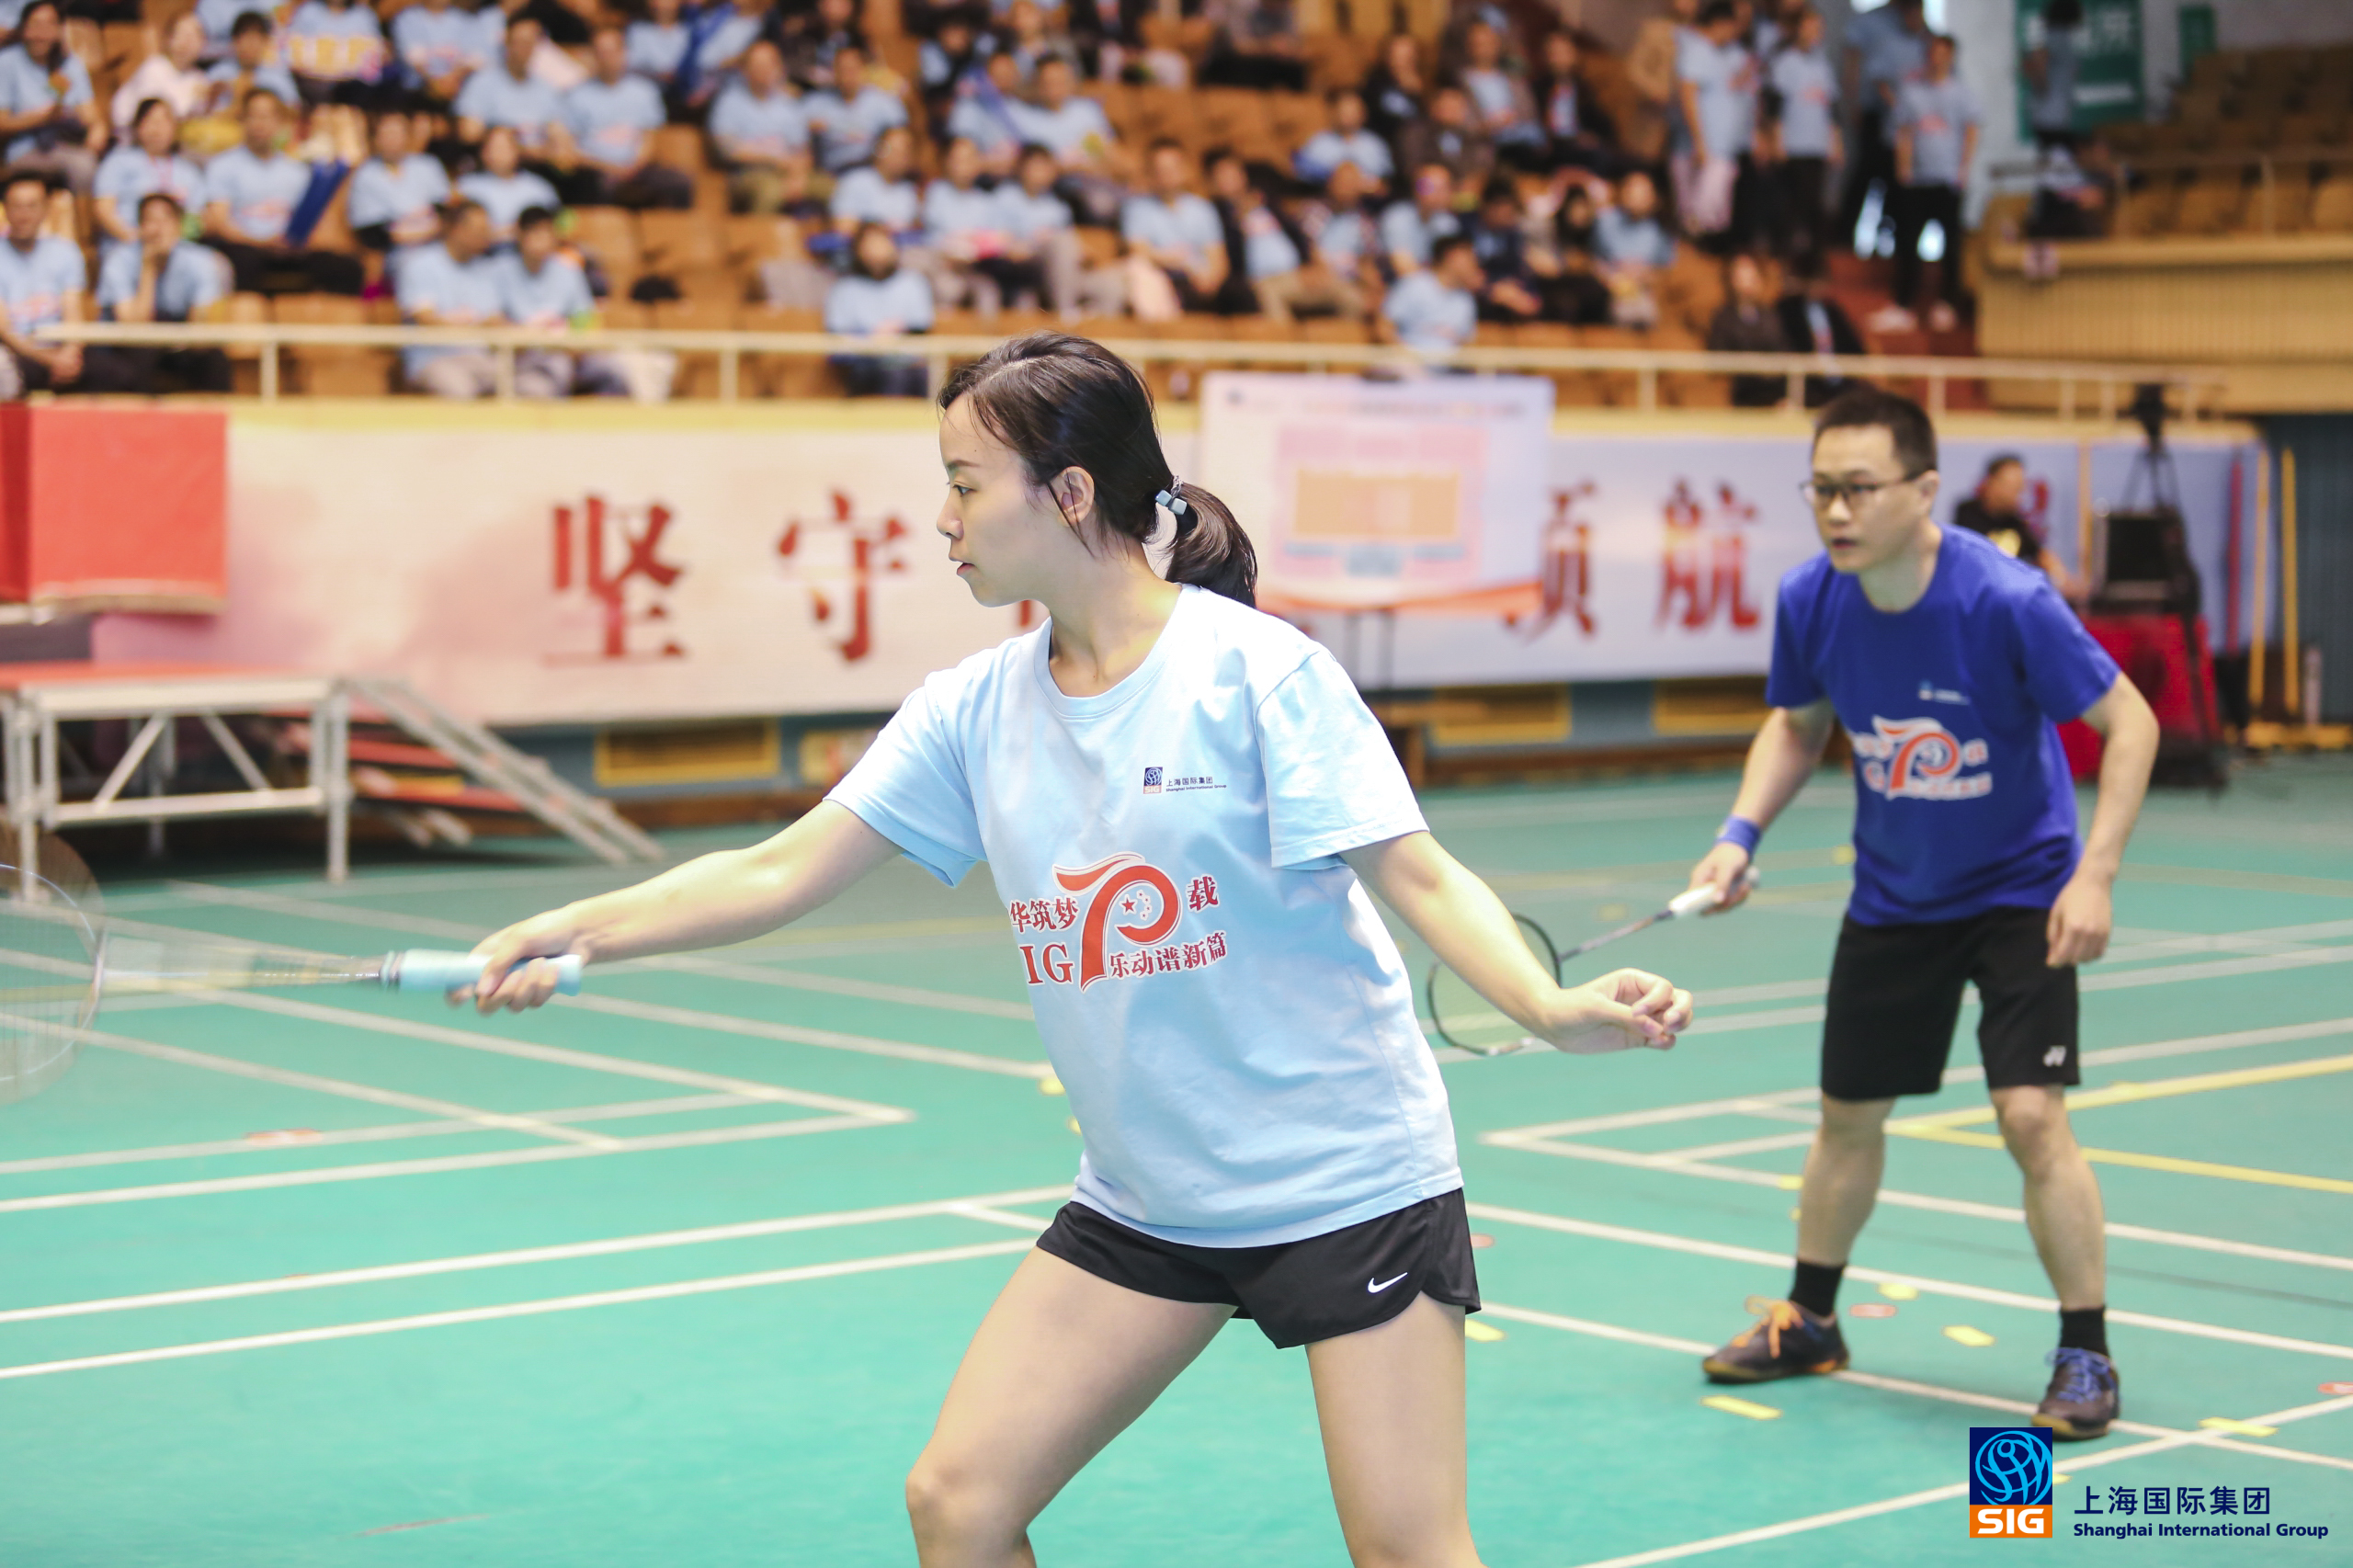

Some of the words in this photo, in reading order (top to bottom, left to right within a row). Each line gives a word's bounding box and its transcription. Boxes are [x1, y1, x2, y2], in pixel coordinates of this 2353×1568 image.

[1166, 777, 1212, 787] 上海国际集团
[1187, 875, 1220, 912] 载
[1109, 931, 1227, 978] 乐动谱新篇
